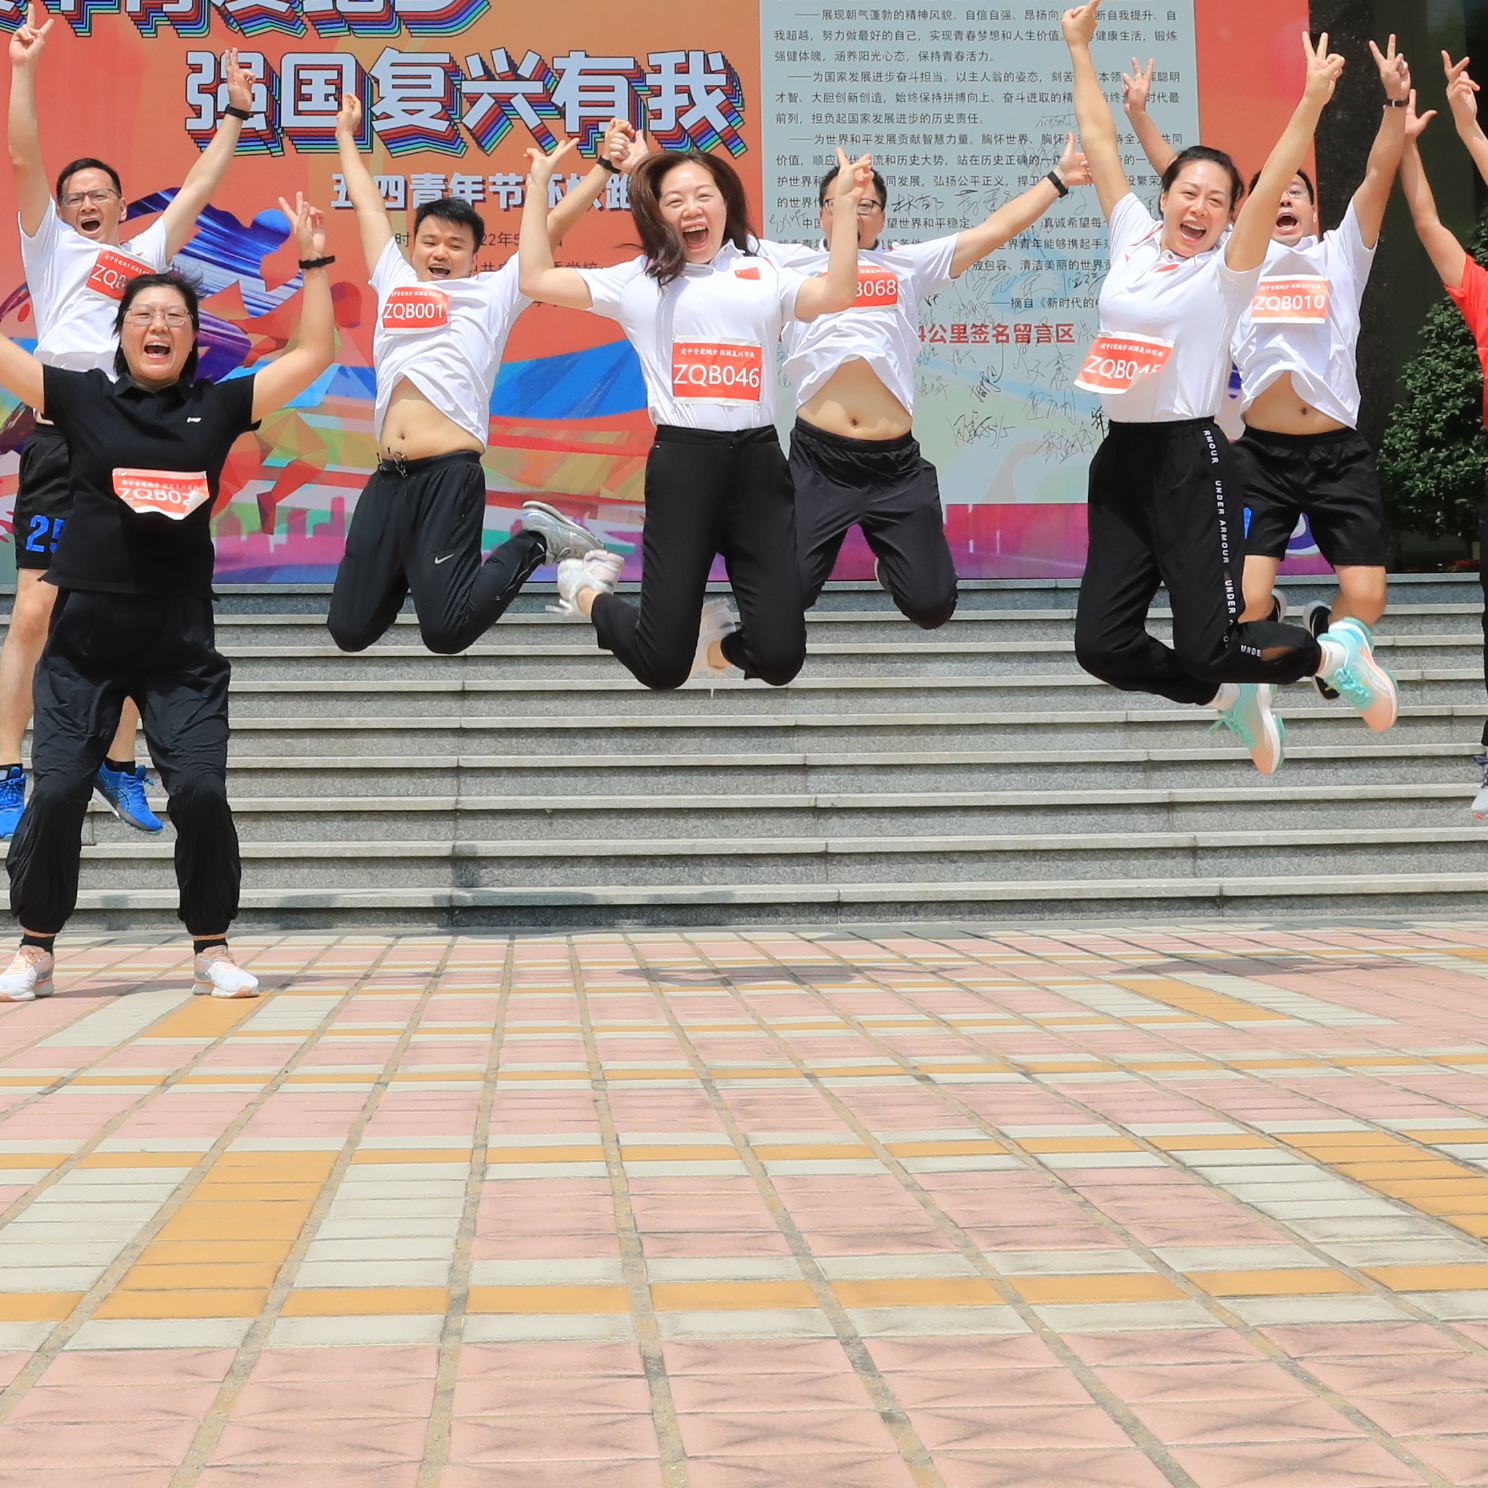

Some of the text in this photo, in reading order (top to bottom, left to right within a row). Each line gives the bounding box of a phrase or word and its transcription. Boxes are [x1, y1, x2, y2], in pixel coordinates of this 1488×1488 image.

[185, 48, 746, 157] 强国复兴有我
[383, 302, 443, 320] ZQB001
[1253, 295, 1325, 311] ZQB010
[673, 364, 760, 388] ZQB046
[1203, 429, 1219, 464] RMOUR
[117, 488, 190, 506] ZQB02
[1215, 480, 1229, 564] UNDER ARMOUR
[1224, 579, 1237, 614] UNDER
[1240, 644, 1262, 658] UNDE
